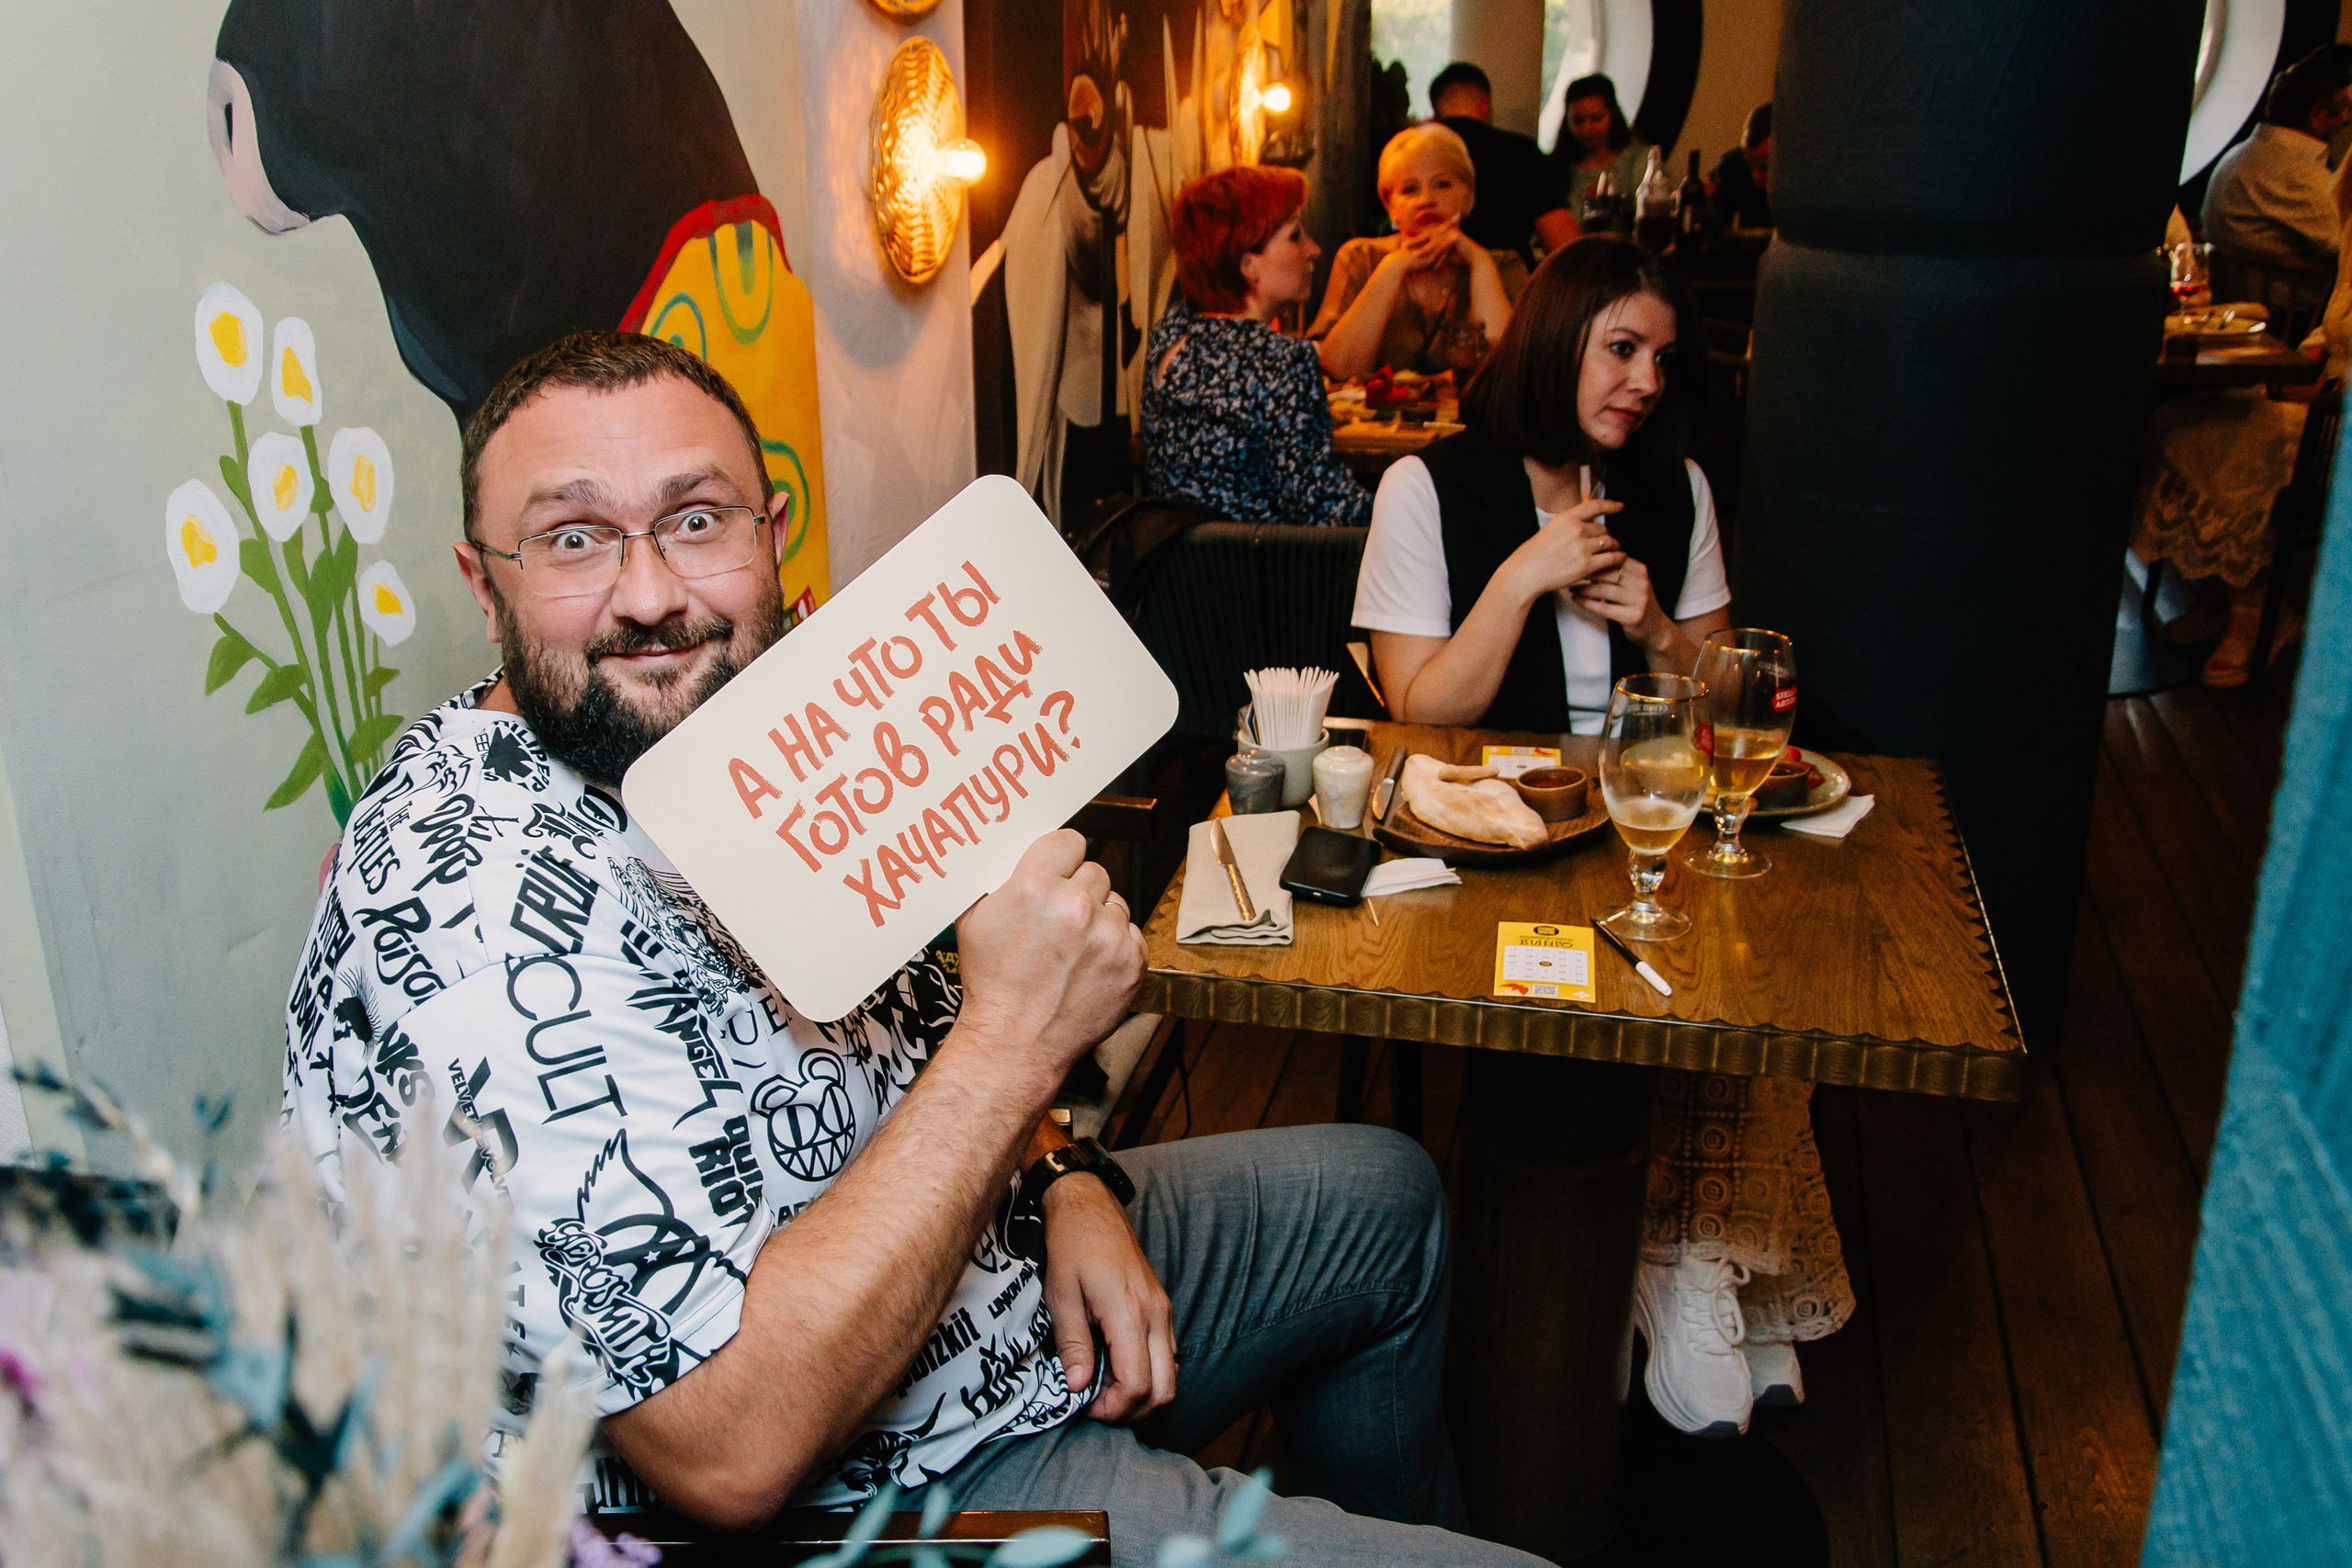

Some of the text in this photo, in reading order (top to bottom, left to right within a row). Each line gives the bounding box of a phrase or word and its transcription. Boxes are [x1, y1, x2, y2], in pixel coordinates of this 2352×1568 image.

[729, 560, 1001, 819] А НА ЧТО ТЫ
[775, 630, 1043, 872] ГОТОВ РАДИ
[843, 690, 1081, 928] ХАЧАПУРИ?
[506, 954, 628, 1125] CULT
